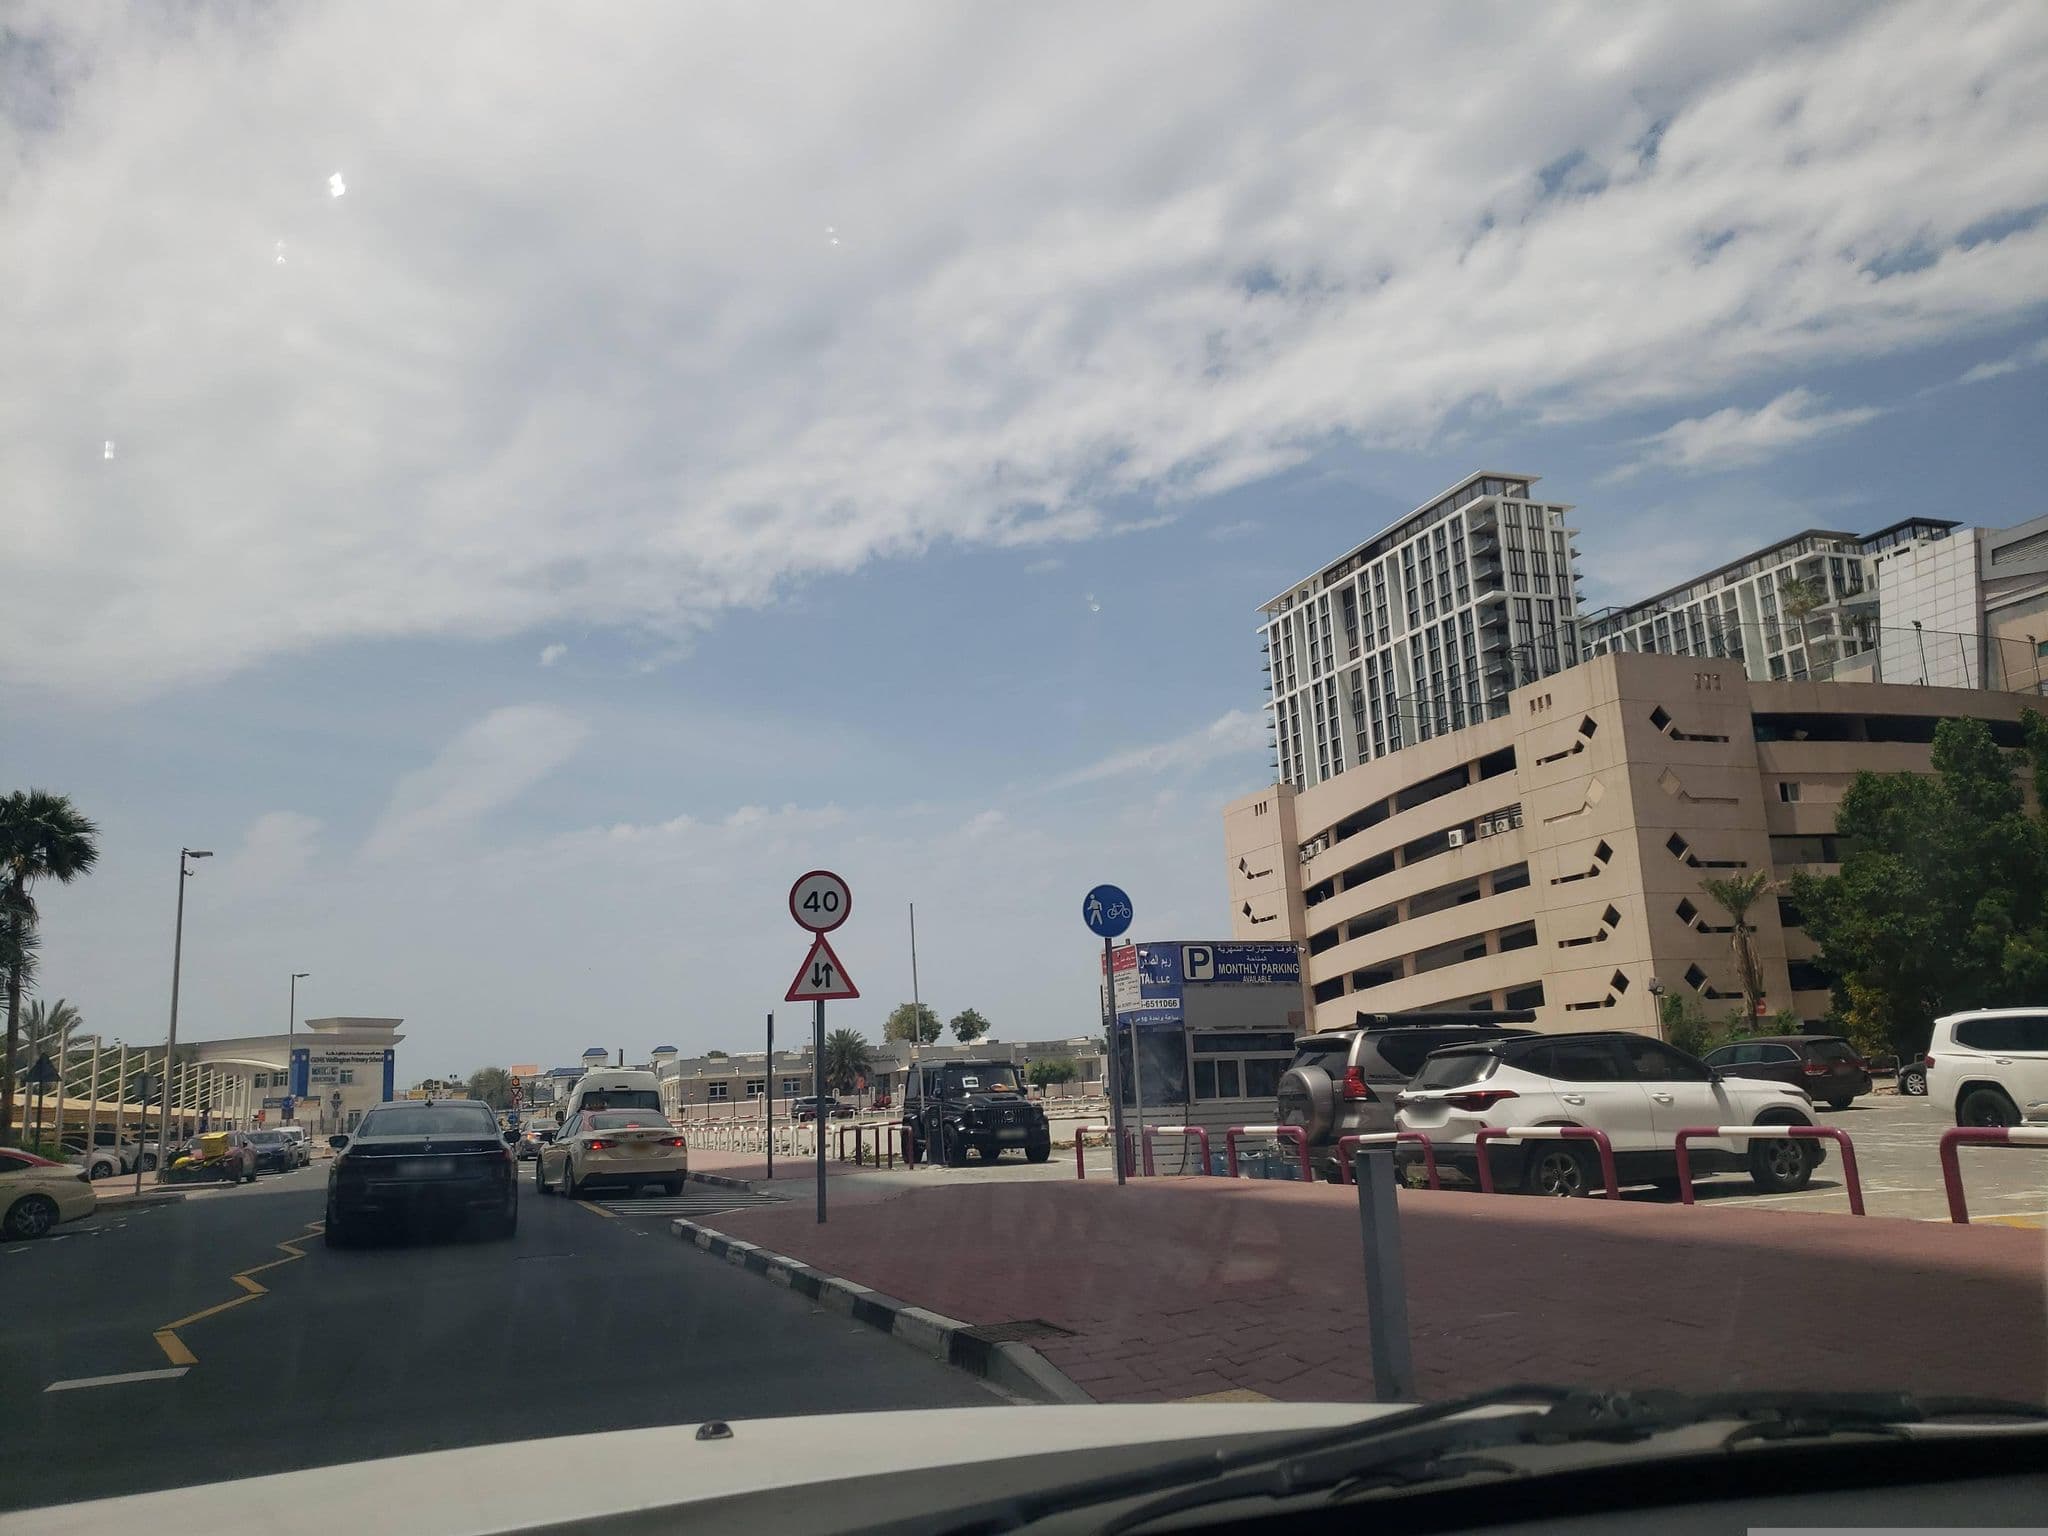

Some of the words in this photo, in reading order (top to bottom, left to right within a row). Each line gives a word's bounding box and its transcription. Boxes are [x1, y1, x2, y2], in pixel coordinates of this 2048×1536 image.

[803, 890, 839, 912] 40
[1188, 947, 1210, 977] P
[1218, 963, 1259, 974] MONTHLY
[1261, 963, 1299, 974] PARKING
[1242, 975, 1273, 984] AVAILABLE
